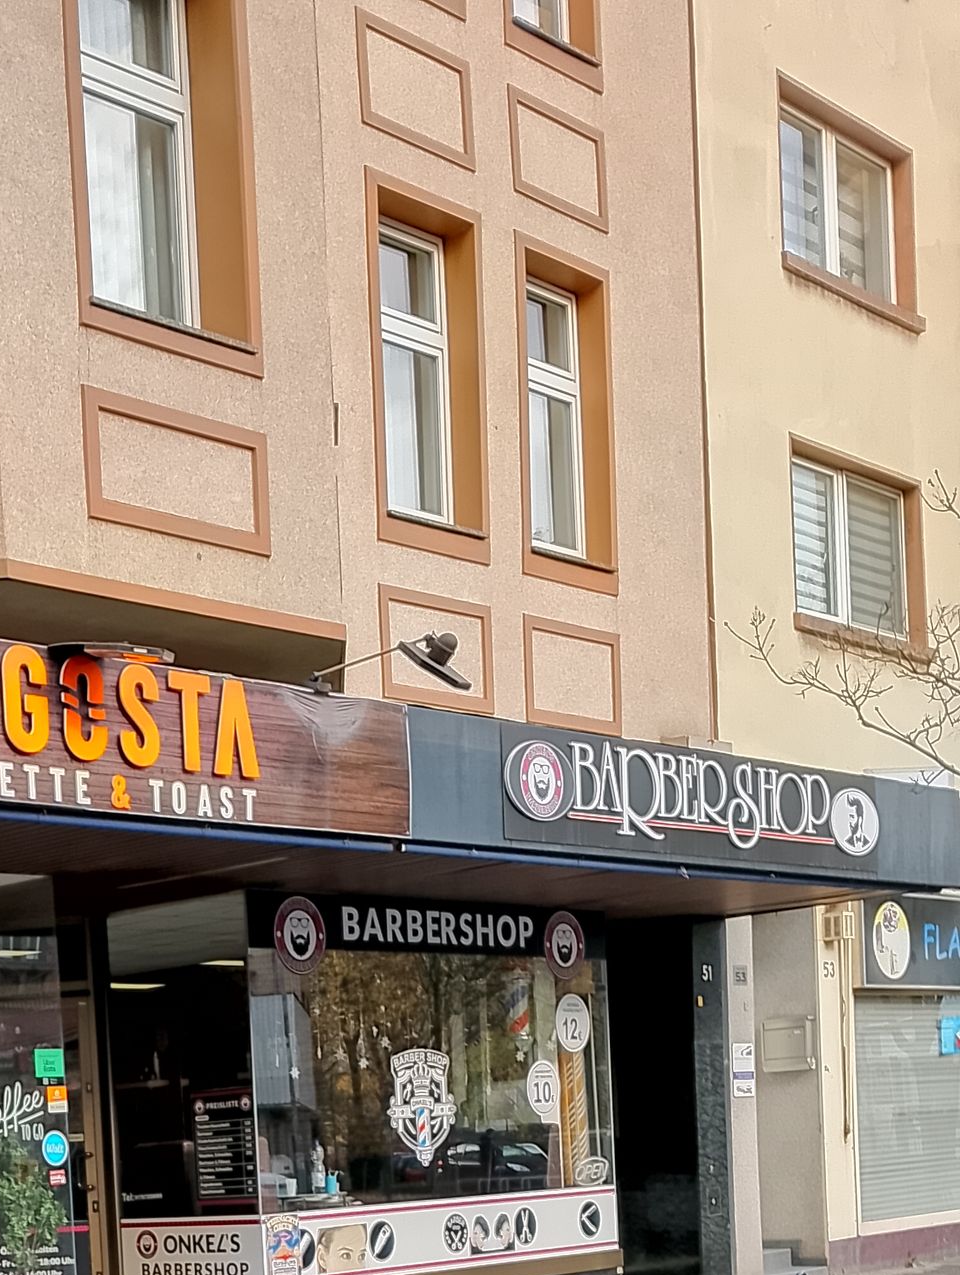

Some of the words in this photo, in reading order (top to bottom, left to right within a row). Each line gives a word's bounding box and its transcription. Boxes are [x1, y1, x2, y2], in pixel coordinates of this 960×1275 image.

[111, 773, 131, 810] &
[148, 778, 257, 821] TOAST
[341, 906, 534, 949] BARBERSHOP
[701, 964, 713, 982] 51
[823, 961, 836, 978] 53
[393, 1052, 425, 1068] BARBER
[426, 1052, 447, 1066] SHOP
[21, 1123, 31, 1141] TO
[32, 1123, 44, 1141] GO
[163, 1233, 241, 1254] ONKEL'S
